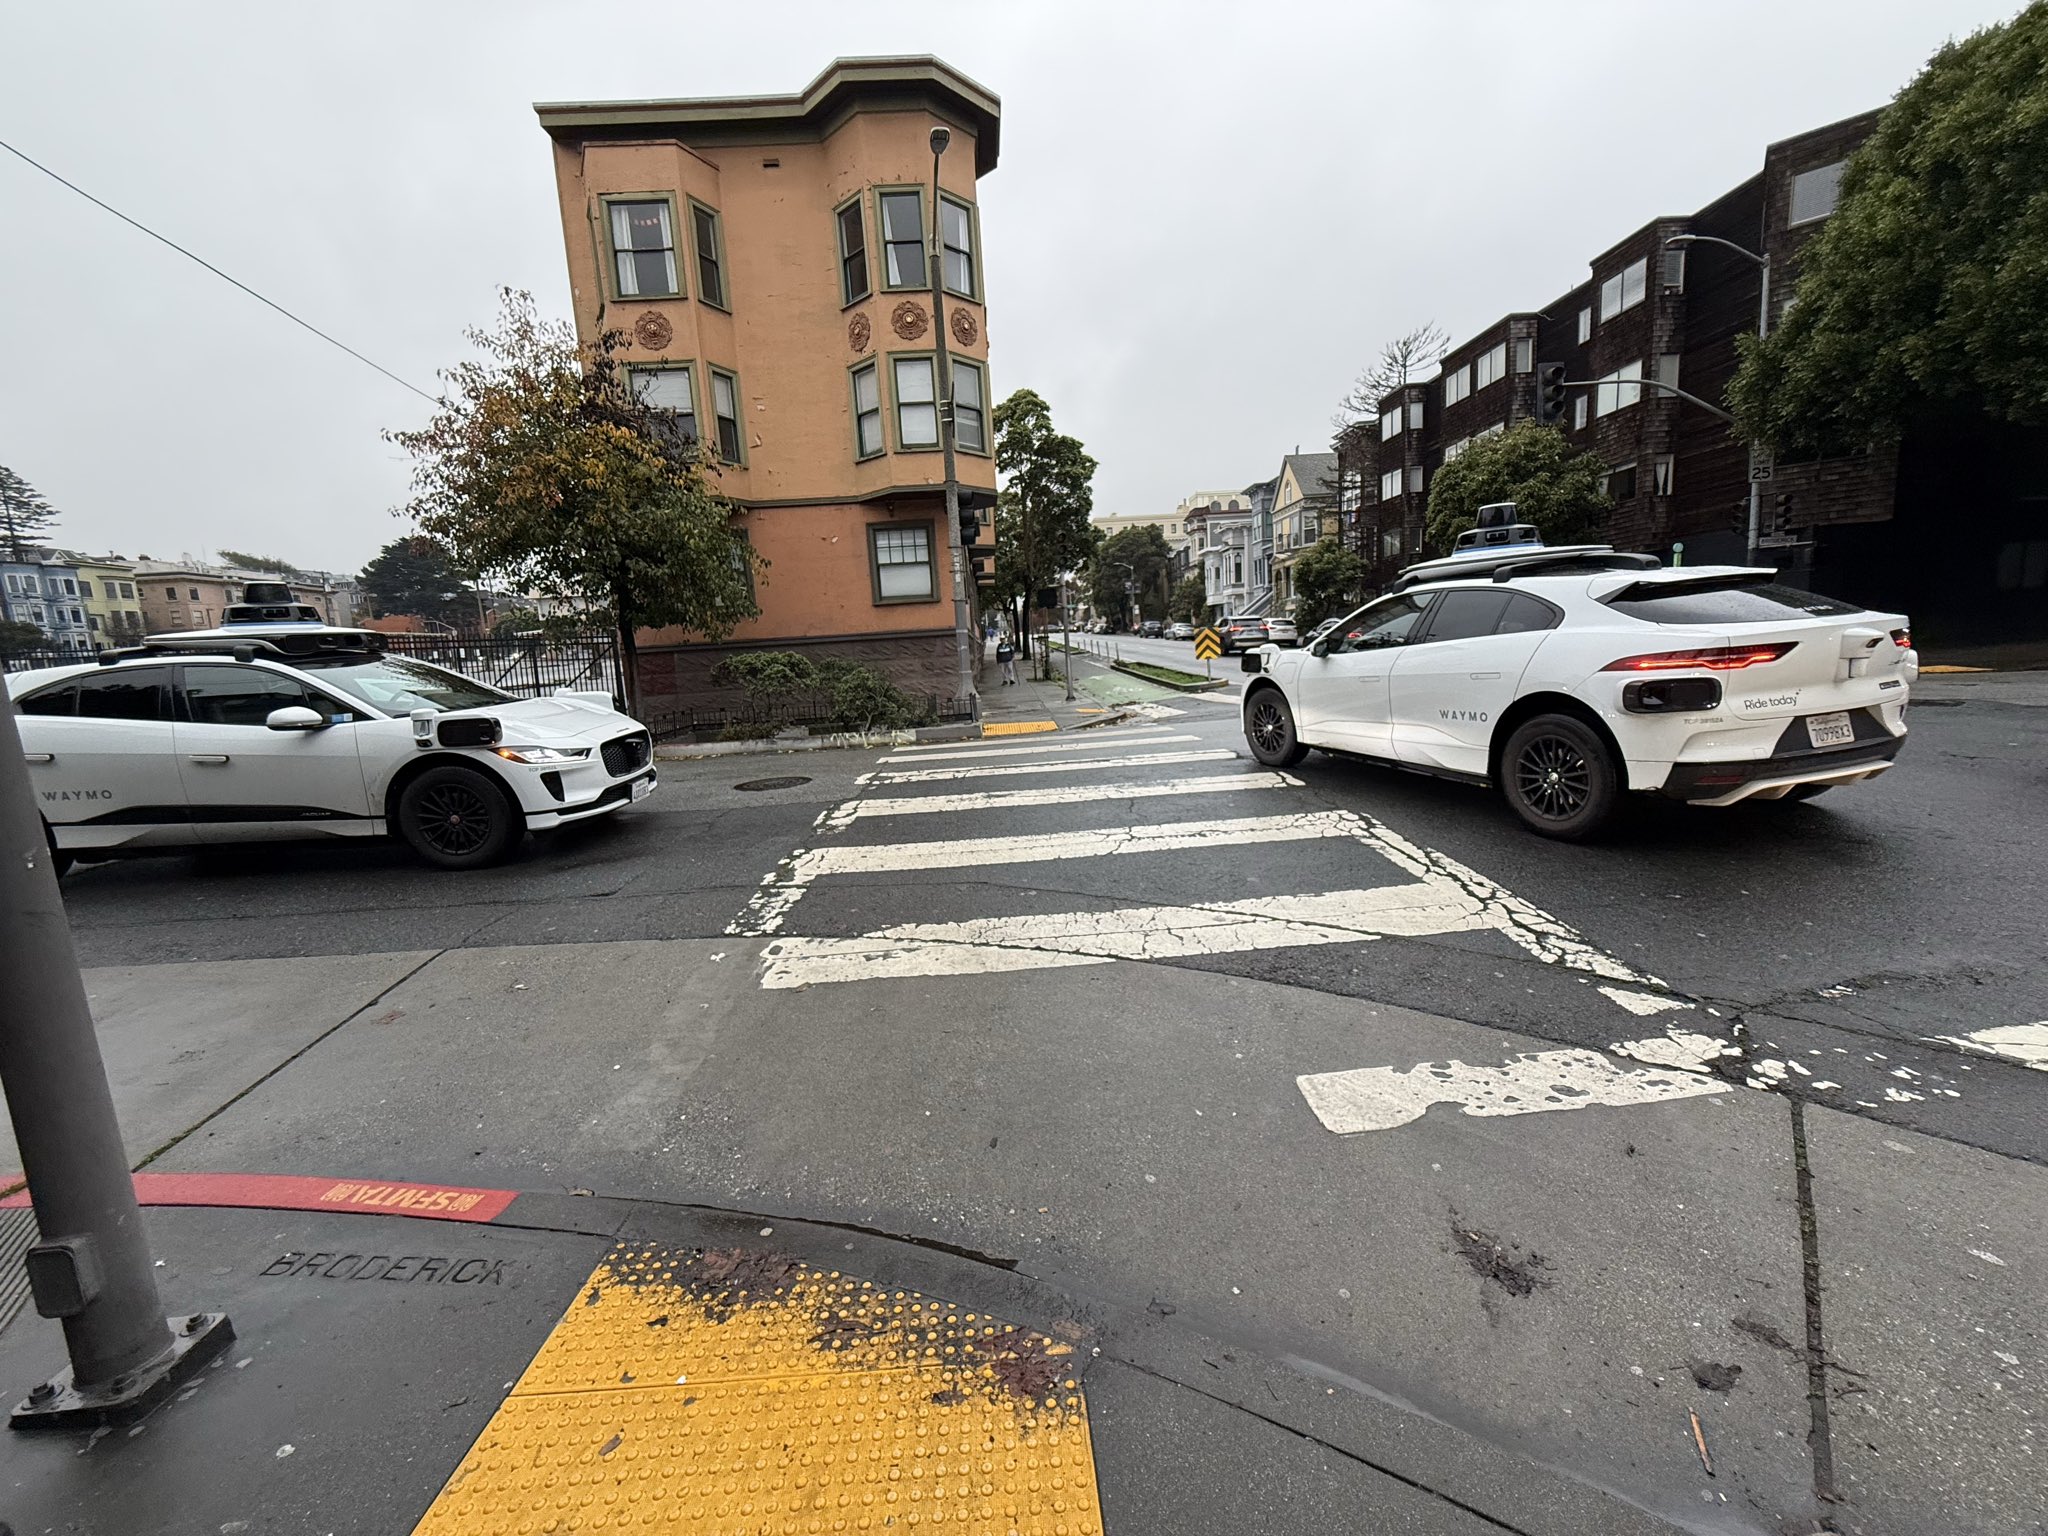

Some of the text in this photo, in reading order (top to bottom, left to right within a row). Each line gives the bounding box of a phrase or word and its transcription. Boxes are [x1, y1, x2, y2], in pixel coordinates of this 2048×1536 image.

[1751, 466, 1771, 480] 25
[1743, 694, 1797, 710] Ride today
[1438, 709, 1488, 722] WAYMO
[41, 789, 113, 801] WAYMO
[351, 1184, 453, 1211] SFMTA
[258, 1252, 515, 1286] BRODERICK
